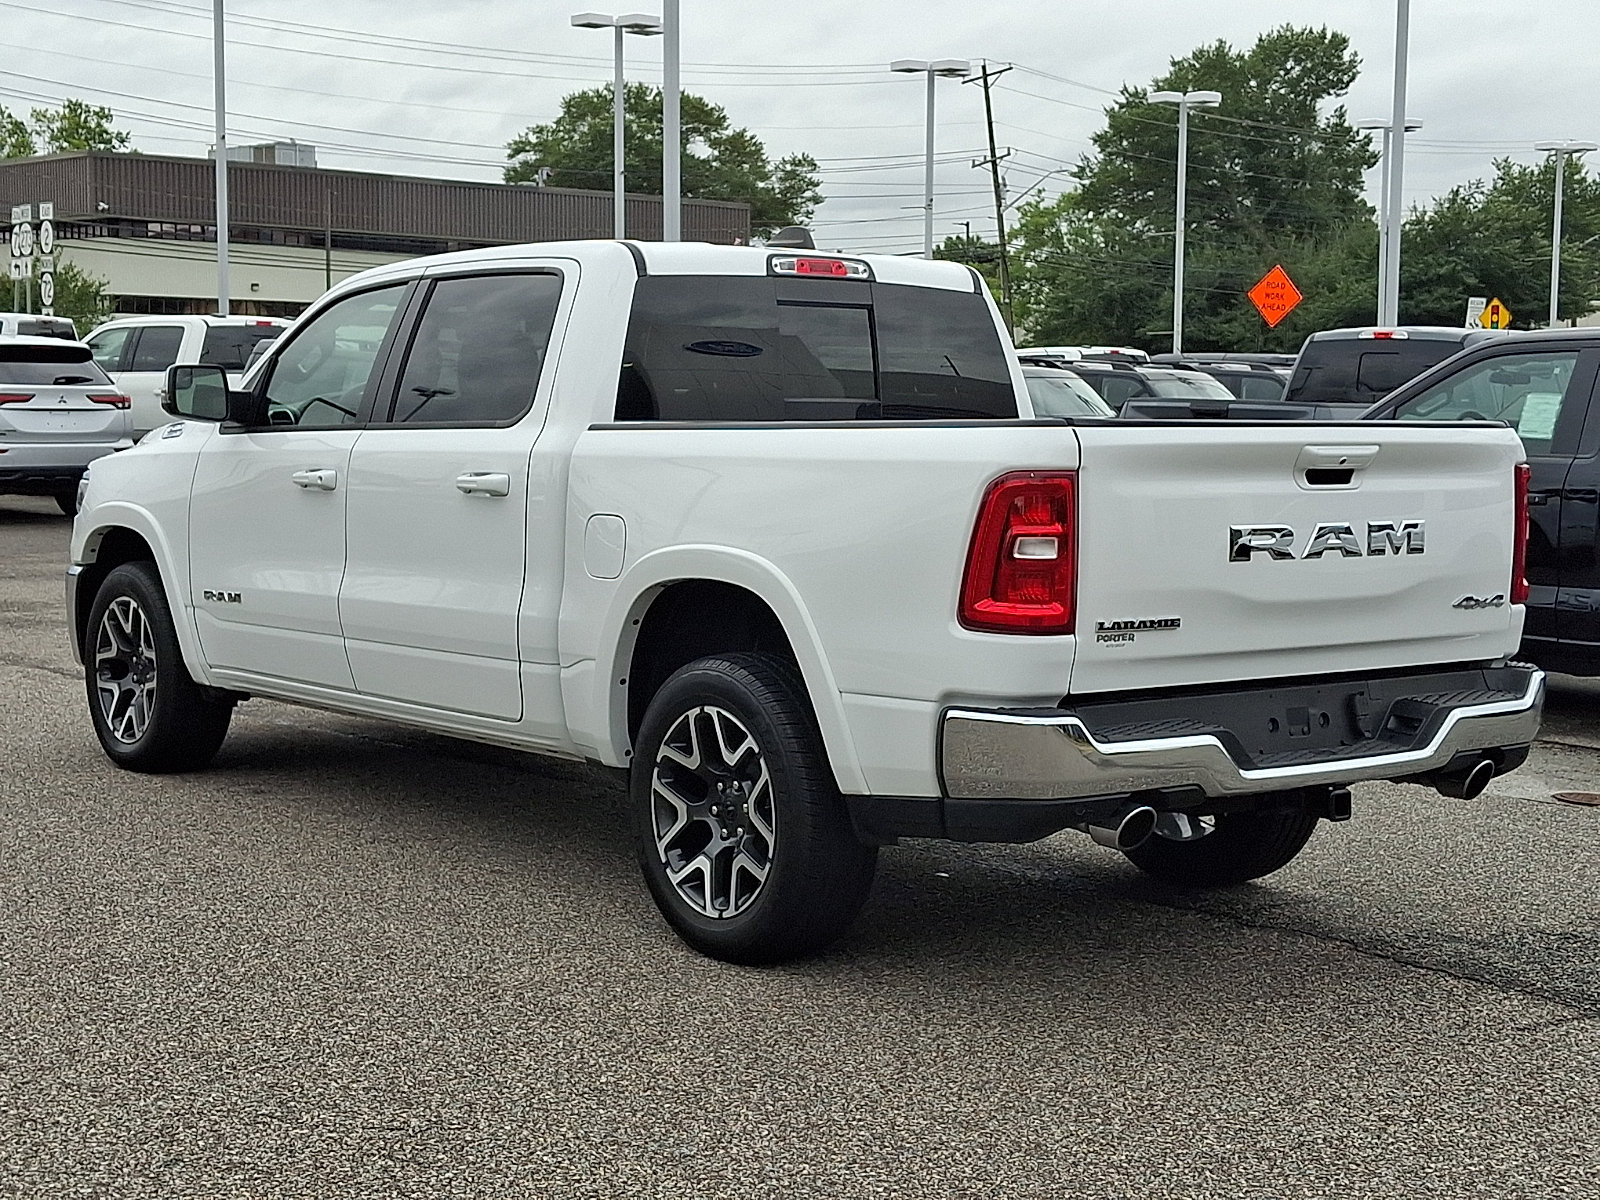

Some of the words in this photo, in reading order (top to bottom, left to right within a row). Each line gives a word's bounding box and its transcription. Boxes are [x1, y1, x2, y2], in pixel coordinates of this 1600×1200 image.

[44, 228, 50, 246] 2
[43, 280, 52, 298] 72
[1266, 281, 1286, 290] ROAD
[1265, 292, 1285, 301] WORK
[1261, 303, 1286, 311] AHEAD
[1229, 520, 1426, 562] RAM
[203, 590, 242, 604] RAM
[1096, 618, 1181, 632] LARAMIE
[1096, 633, 1136, 643] PORTER
